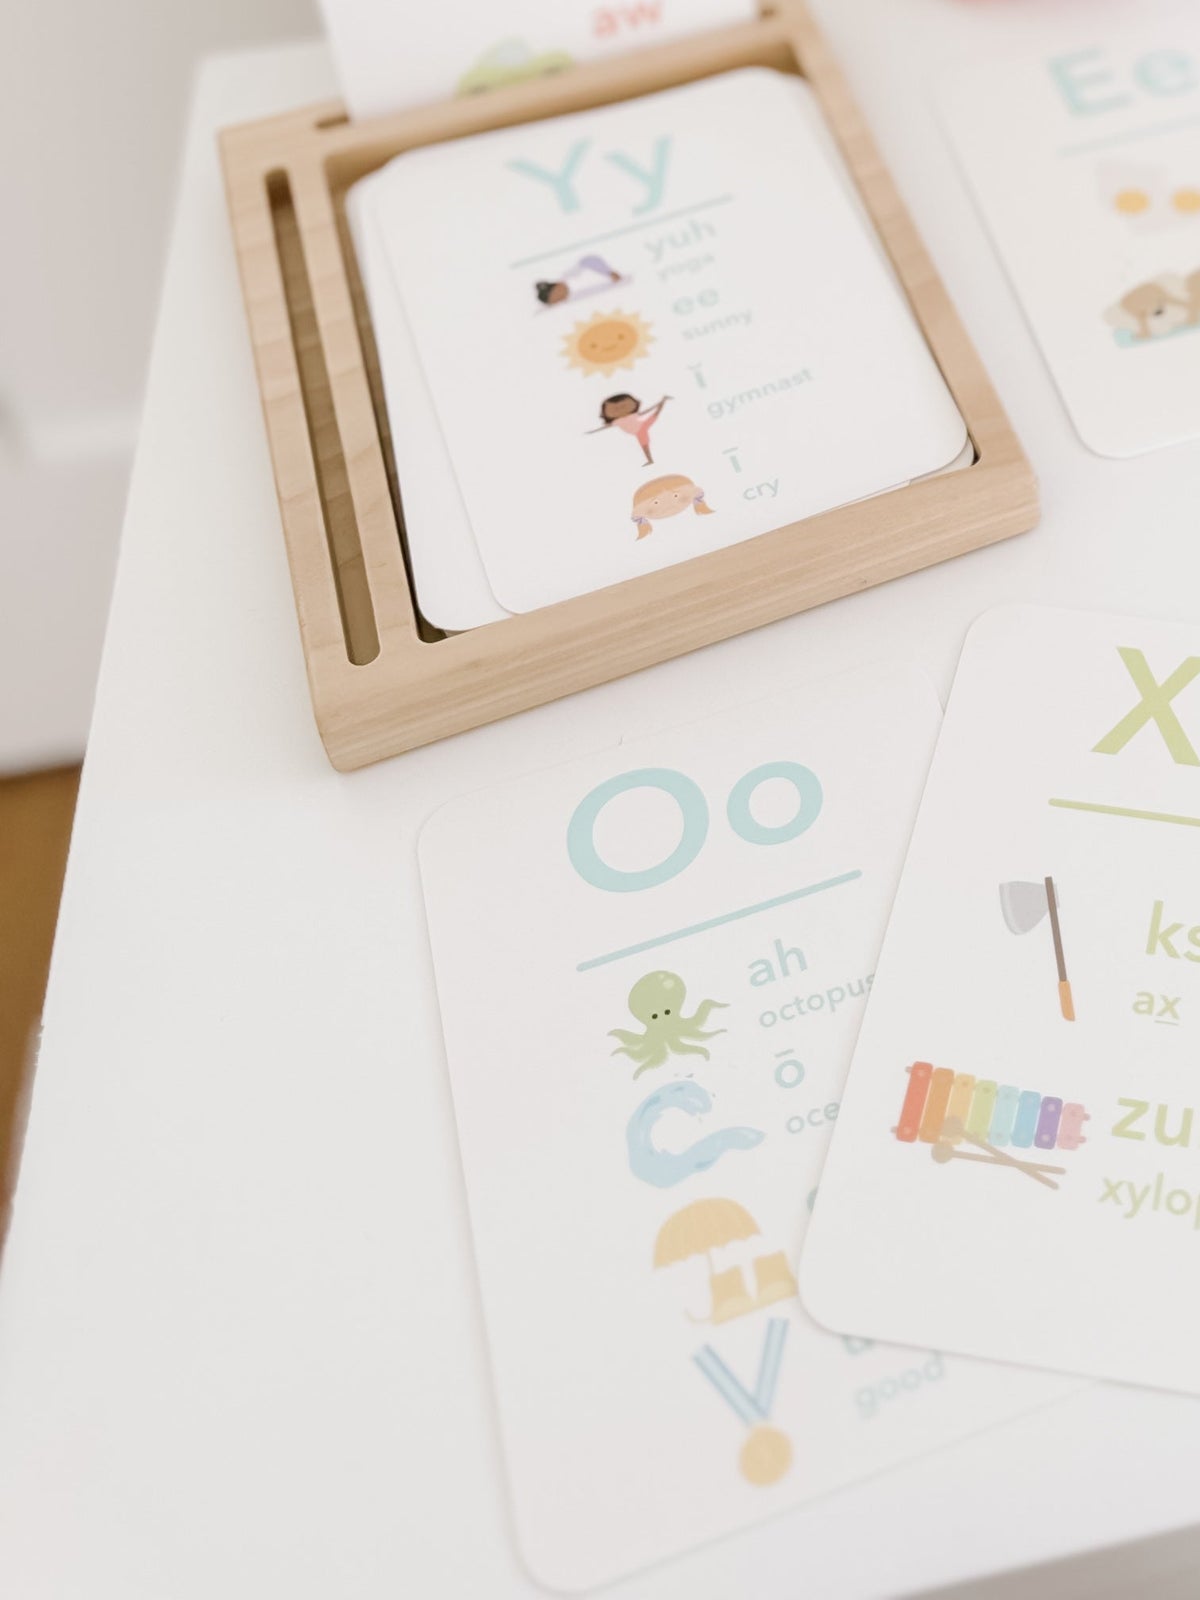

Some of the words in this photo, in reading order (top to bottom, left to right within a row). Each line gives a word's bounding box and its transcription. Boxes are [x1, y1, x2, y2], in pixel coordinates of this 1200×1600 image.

[592, 0, 665, 38] aw
[1046, 46, 1199, 118] Ee
[505, 136, 672, 215] Yy
[645, 219, 716, 263] yuh
[672, 289, 719, 316] ee
[682, 309, 752, 341] sunny
[707, 368, 813, 420] gymnast
[742, 477, 780, 501] cry
[566, 761, 823, 893] Oo
[748, 939, 808, 988] ah
[759, 974, 875, 1029] octopus
[1131, 987, 1182, 1024] ax
[786, 1101, 840, 1135] oce
